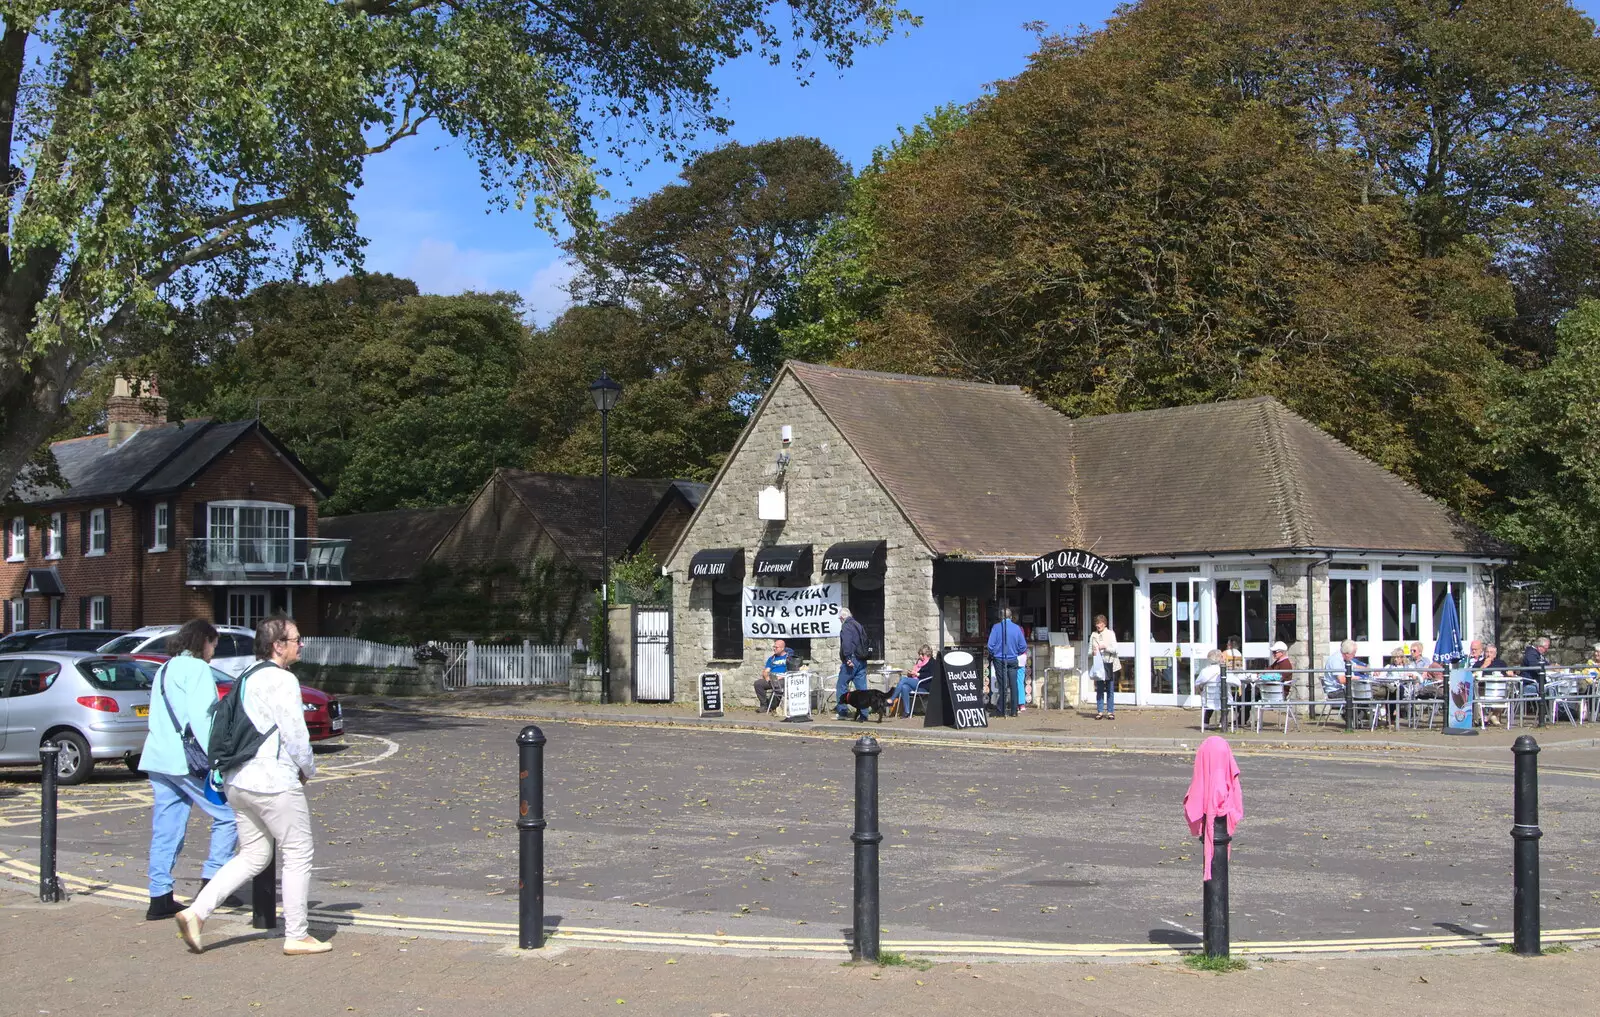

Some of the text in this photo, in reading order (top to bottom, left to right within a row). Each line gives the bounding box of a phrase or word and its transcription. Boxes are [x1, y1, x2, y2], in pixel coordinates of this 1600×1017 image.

[694, 563, 725, 575] Old Mill
[758, 560, 793, 573] Licensed
[824, 558, 869, 571] Tea Rooms
[1032, 551, 1109, 578] The Old Mill
[752, 586, 830, 600] TAKE-AWAY
[745, 603, 838, 617] FISH & CHIPS
[751, 621, 830, 635] SOLD HERE
[947, 670, 977, 680] Hot/Cold
[952, 681, 977, 691] Food &
[790, 691, 807, 699] CHIPS
[956, 693, 978, 702] Drinks
[956, 707, 987, 728] OPEN
